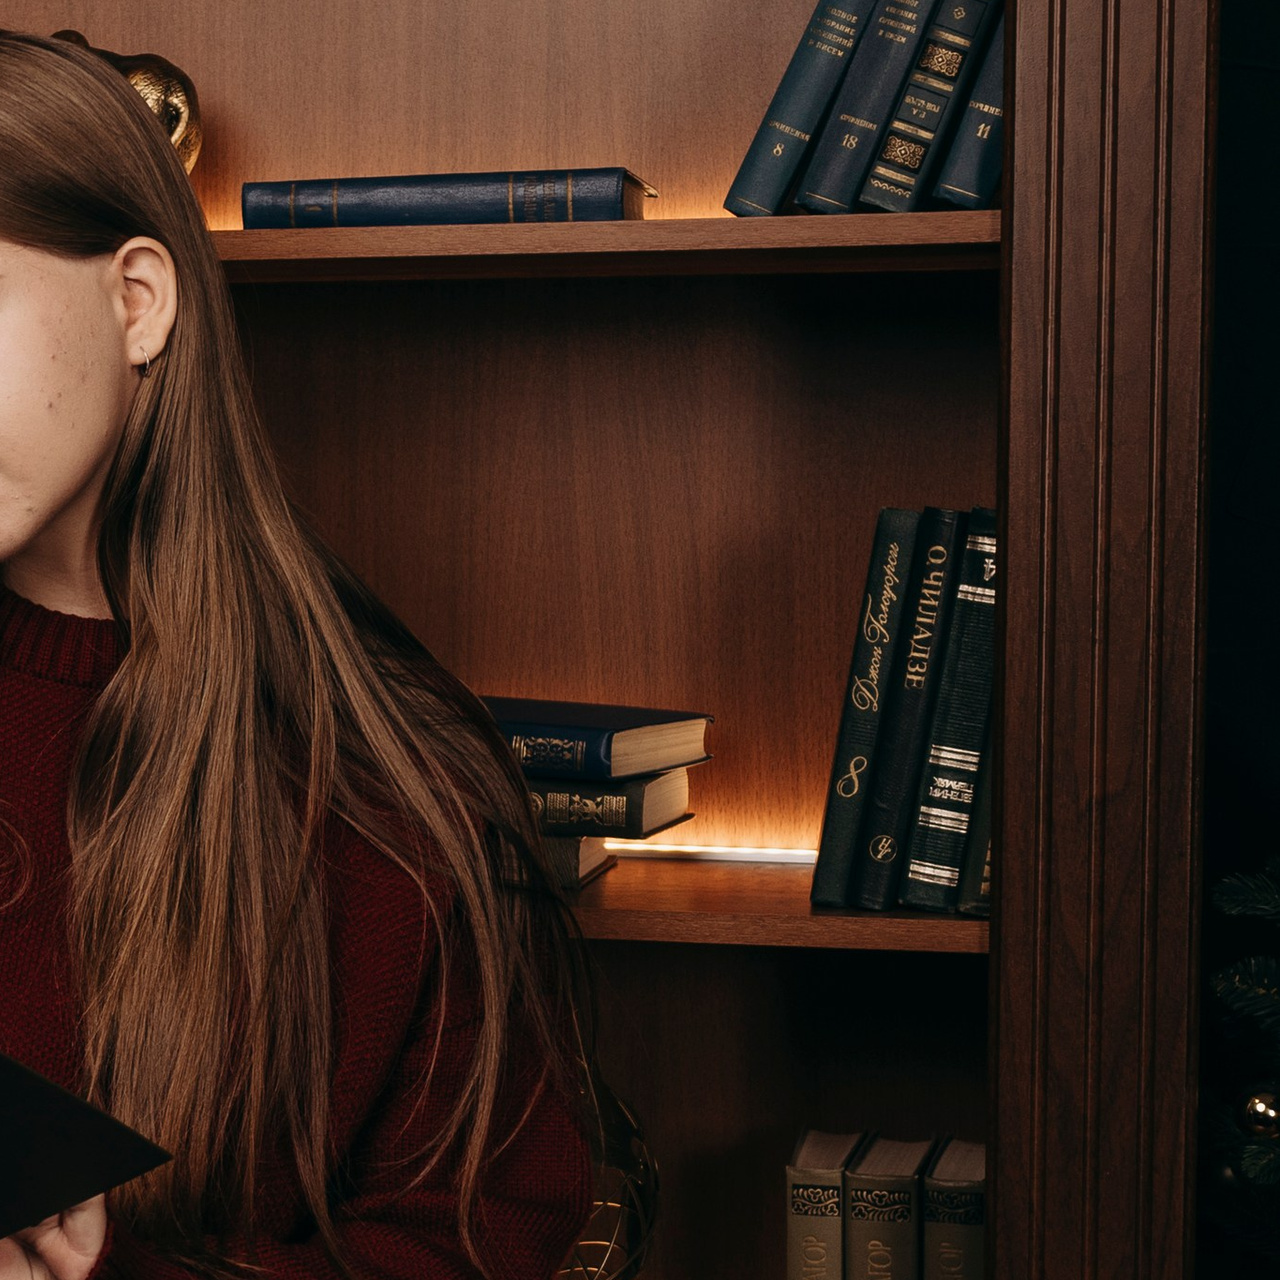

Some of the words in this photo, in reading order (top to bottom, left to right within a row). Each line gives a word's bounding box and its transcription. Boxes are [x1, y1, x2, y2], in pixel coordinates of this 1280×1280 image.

[969, 100, 1004, 117] СОЧИНЕ
[976, 122, 992, 140] 11
[773, 143, 785, 158] 8
[840, 133, 860, 150] 18
[863, 541, 900, 643] Голсуорси
[904, 570, 945, 690] ЧИЛАДЗЕ
[851, 646, 883, 712] Джон
[836, 755, 868, 798] 8
[932, 776, 975, 793] ПЕРМЯК
[928, 786, 975, 804] ЕВГЕНИЙ
